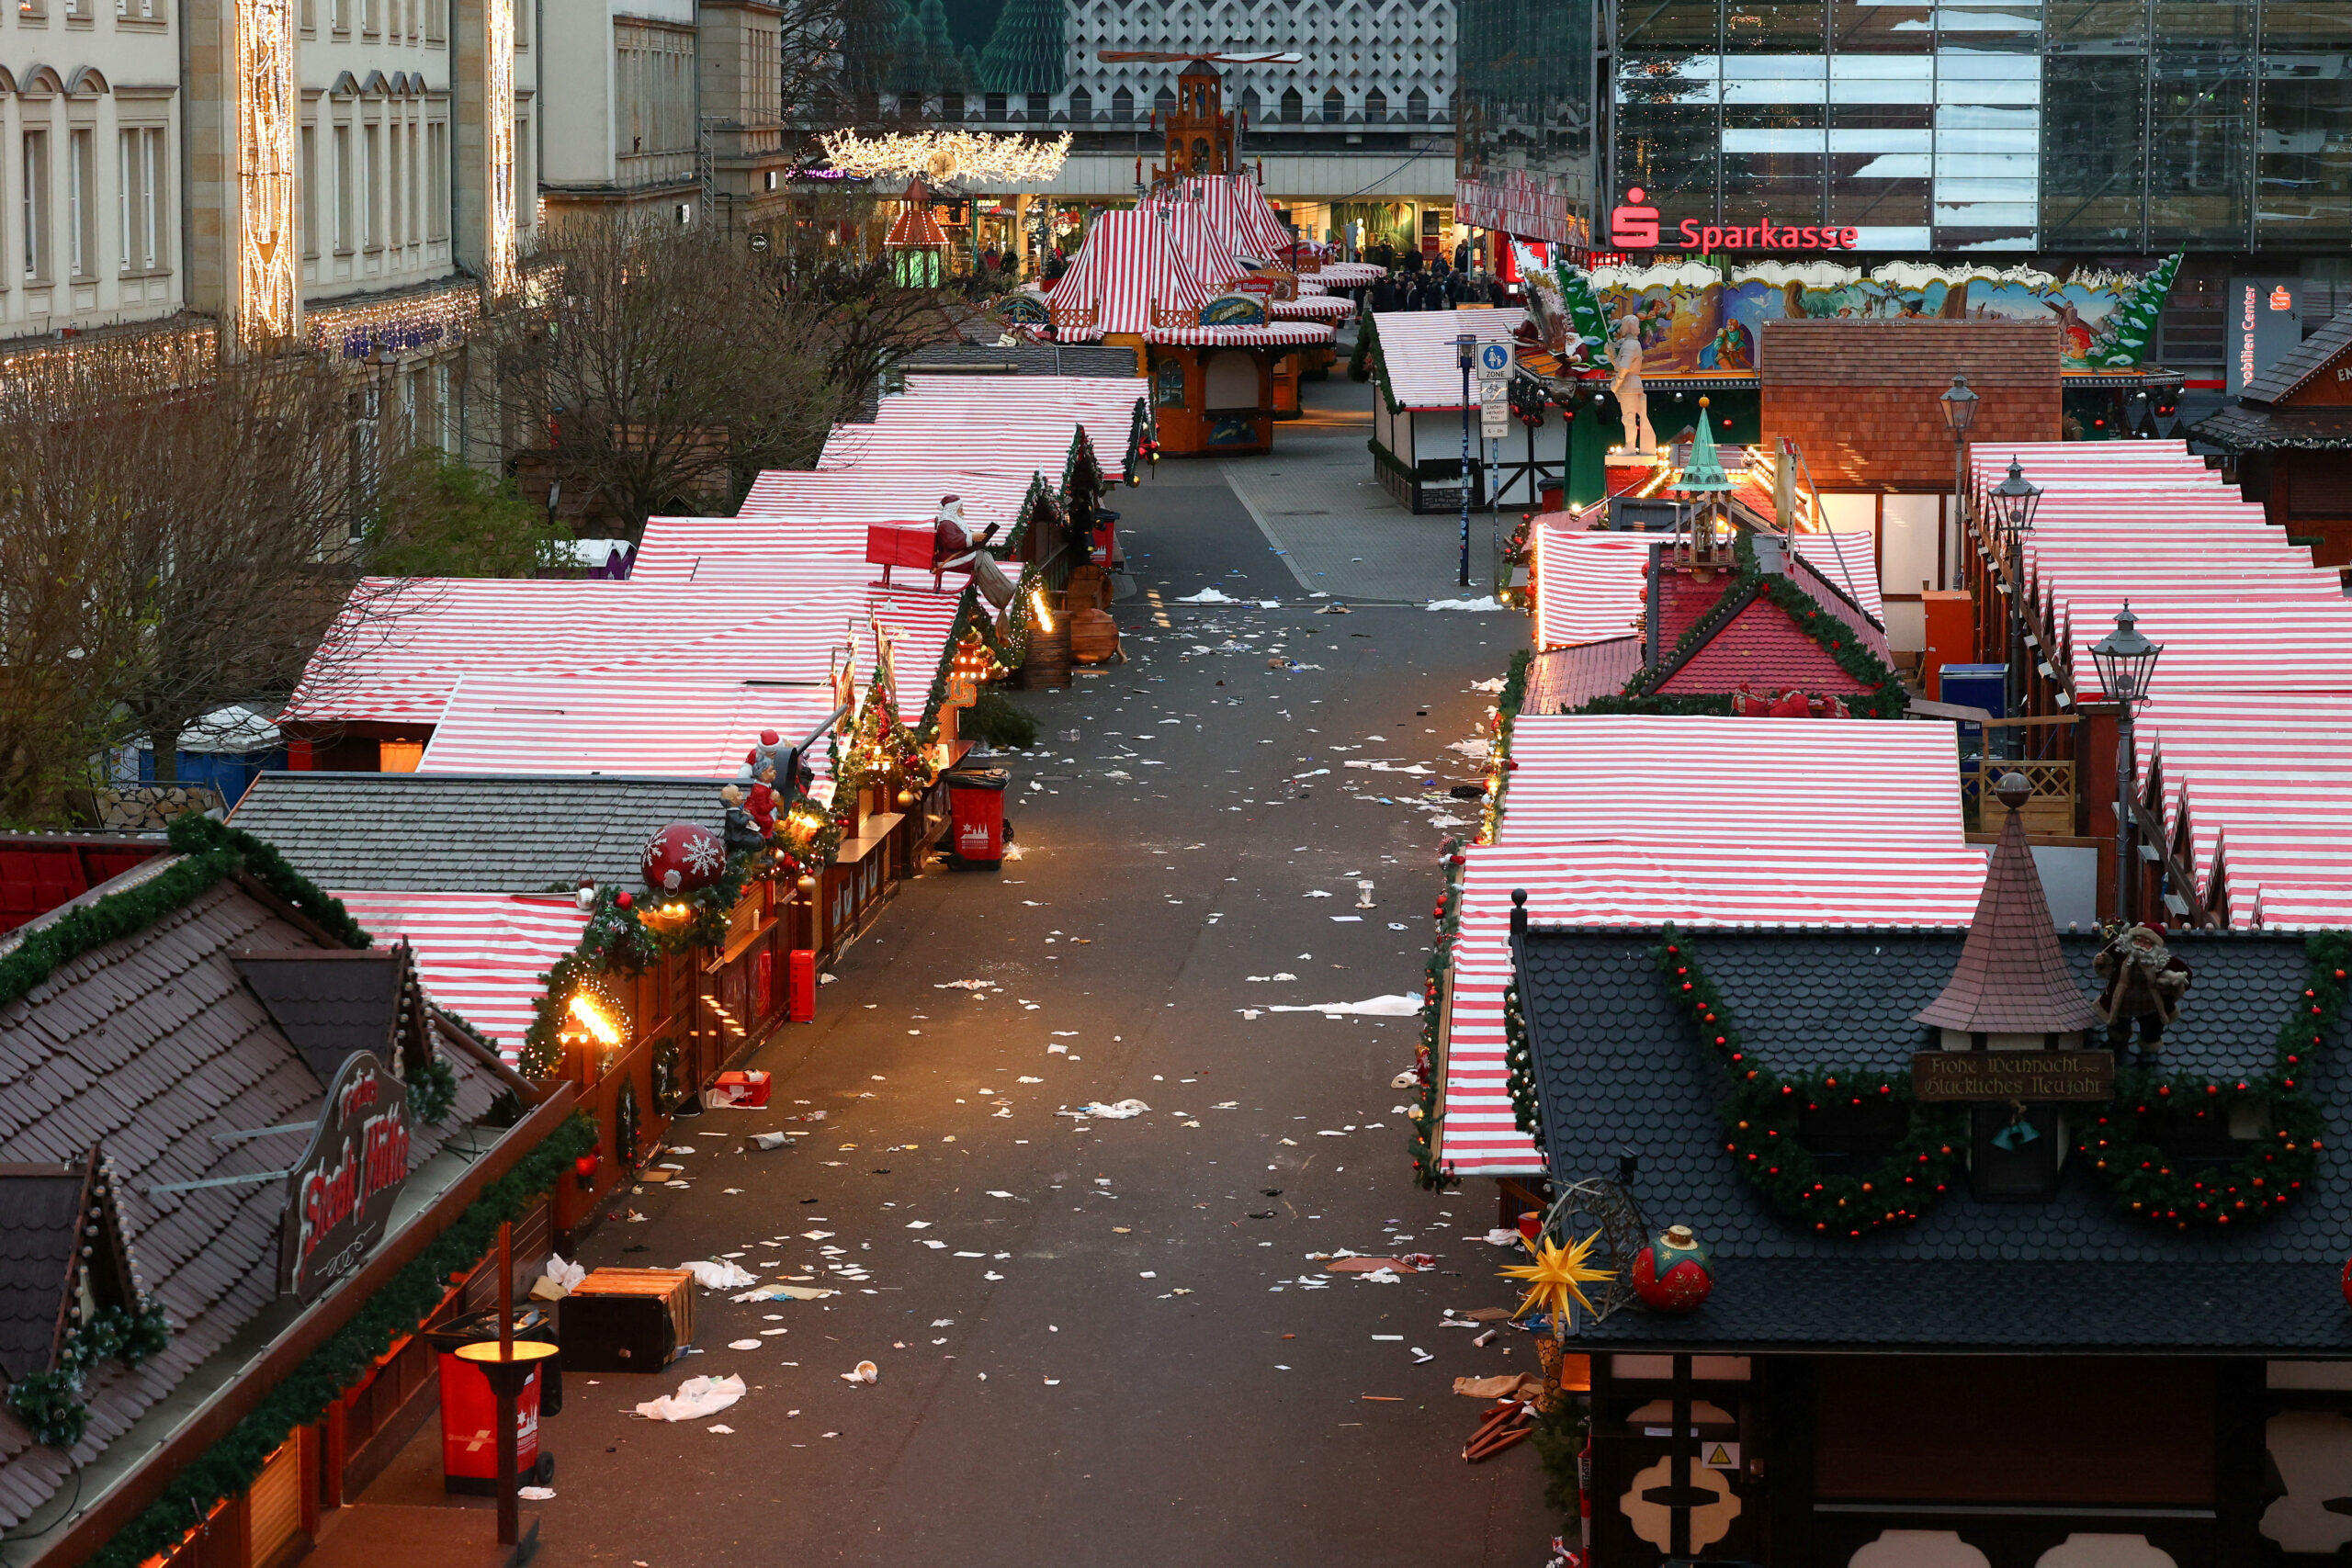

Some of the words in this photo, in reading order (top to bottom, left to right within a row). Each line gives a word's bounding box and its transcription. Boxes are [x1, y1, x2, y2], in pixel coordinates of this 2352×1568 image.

[1679, 218, 1859, 255] Sparkasse
[2242, 285, 2256, 331] Center
[1932, 1057, 1976, 1074] Frohe
[2031, 1077, 2102, 1095] Neujahr
